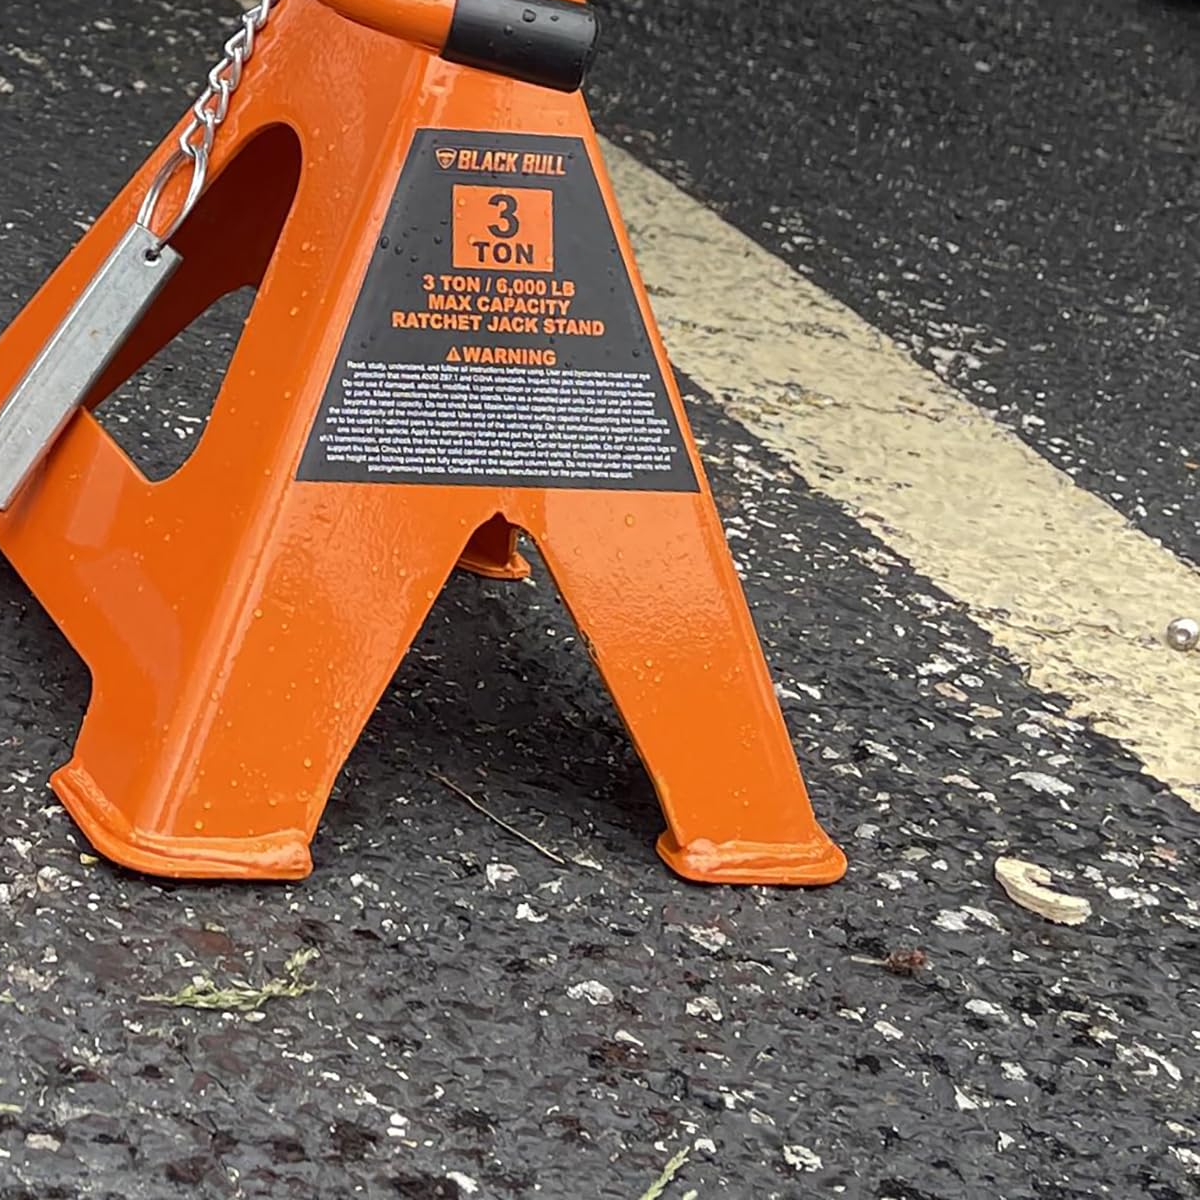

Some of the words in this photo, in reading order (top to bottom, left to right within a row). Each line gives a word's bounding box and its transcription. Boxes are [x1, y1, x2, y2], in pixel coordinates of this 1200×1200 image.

[458, 150, 518, 174] BLACK
[522, 154, 566, 176] BULL
[488, 194, 520, 239] 3
[472, 242, 534, 264] TON
[423, 275, 434, 290] 3
[440, 276, 480, 292] TON
[496, 278, 546, 298] 6,000
[552, 281, 575, 296] LB
[428, 294, 472, 311] MAX
[477, 296, 571, 316] CAPACITY
[392, 312, 482, 331] RATCHET
[488, 316, 538, 334] JACK
[543, 318, 604, 336] STAND
[464, 347, 556, 366] WARNING
